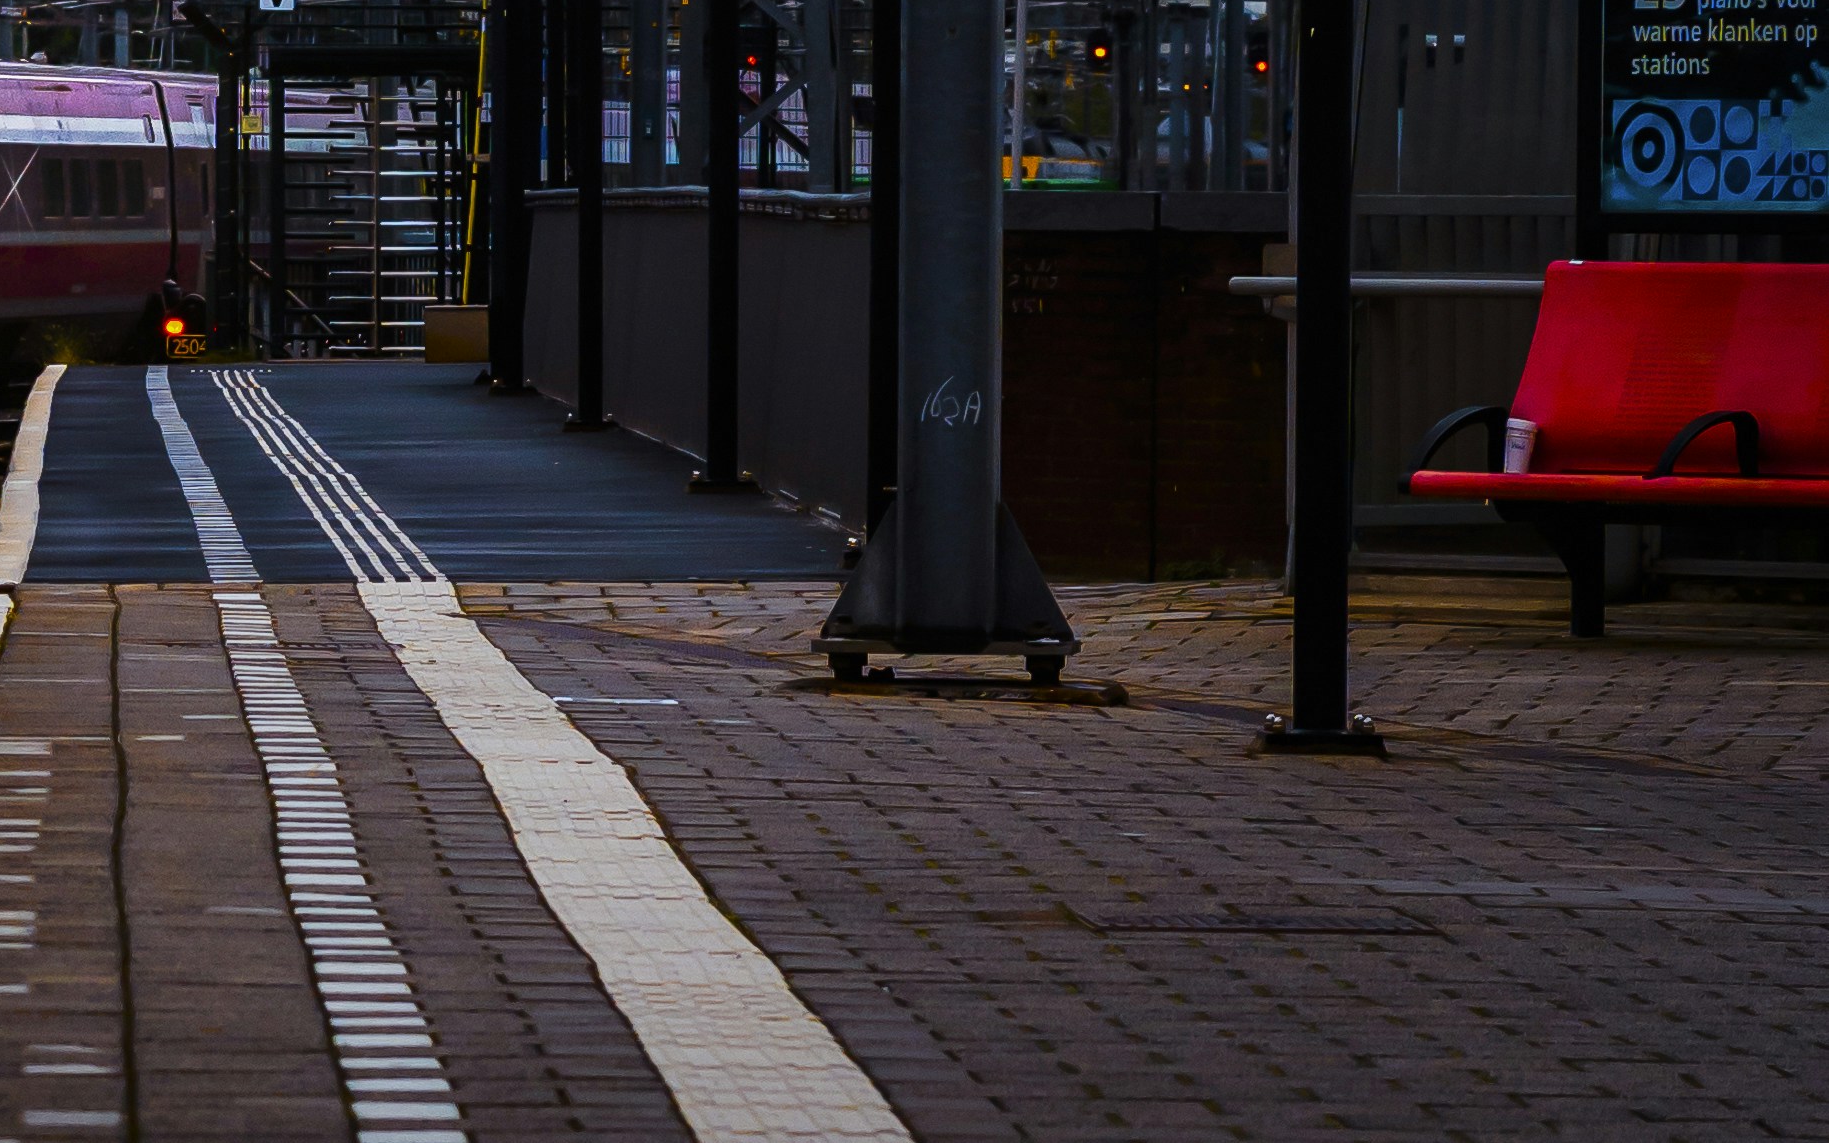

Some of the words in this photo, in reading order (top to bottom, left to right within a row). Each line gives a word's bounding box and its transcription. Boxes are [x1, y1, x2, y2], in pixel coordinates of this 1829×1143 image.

[1632, 24, 1702, 42] warme
[1707, 17, 1788, 42] klanken
[1794, 23, 1818, 48] op
[1631, 51, 1711, 75] stations
